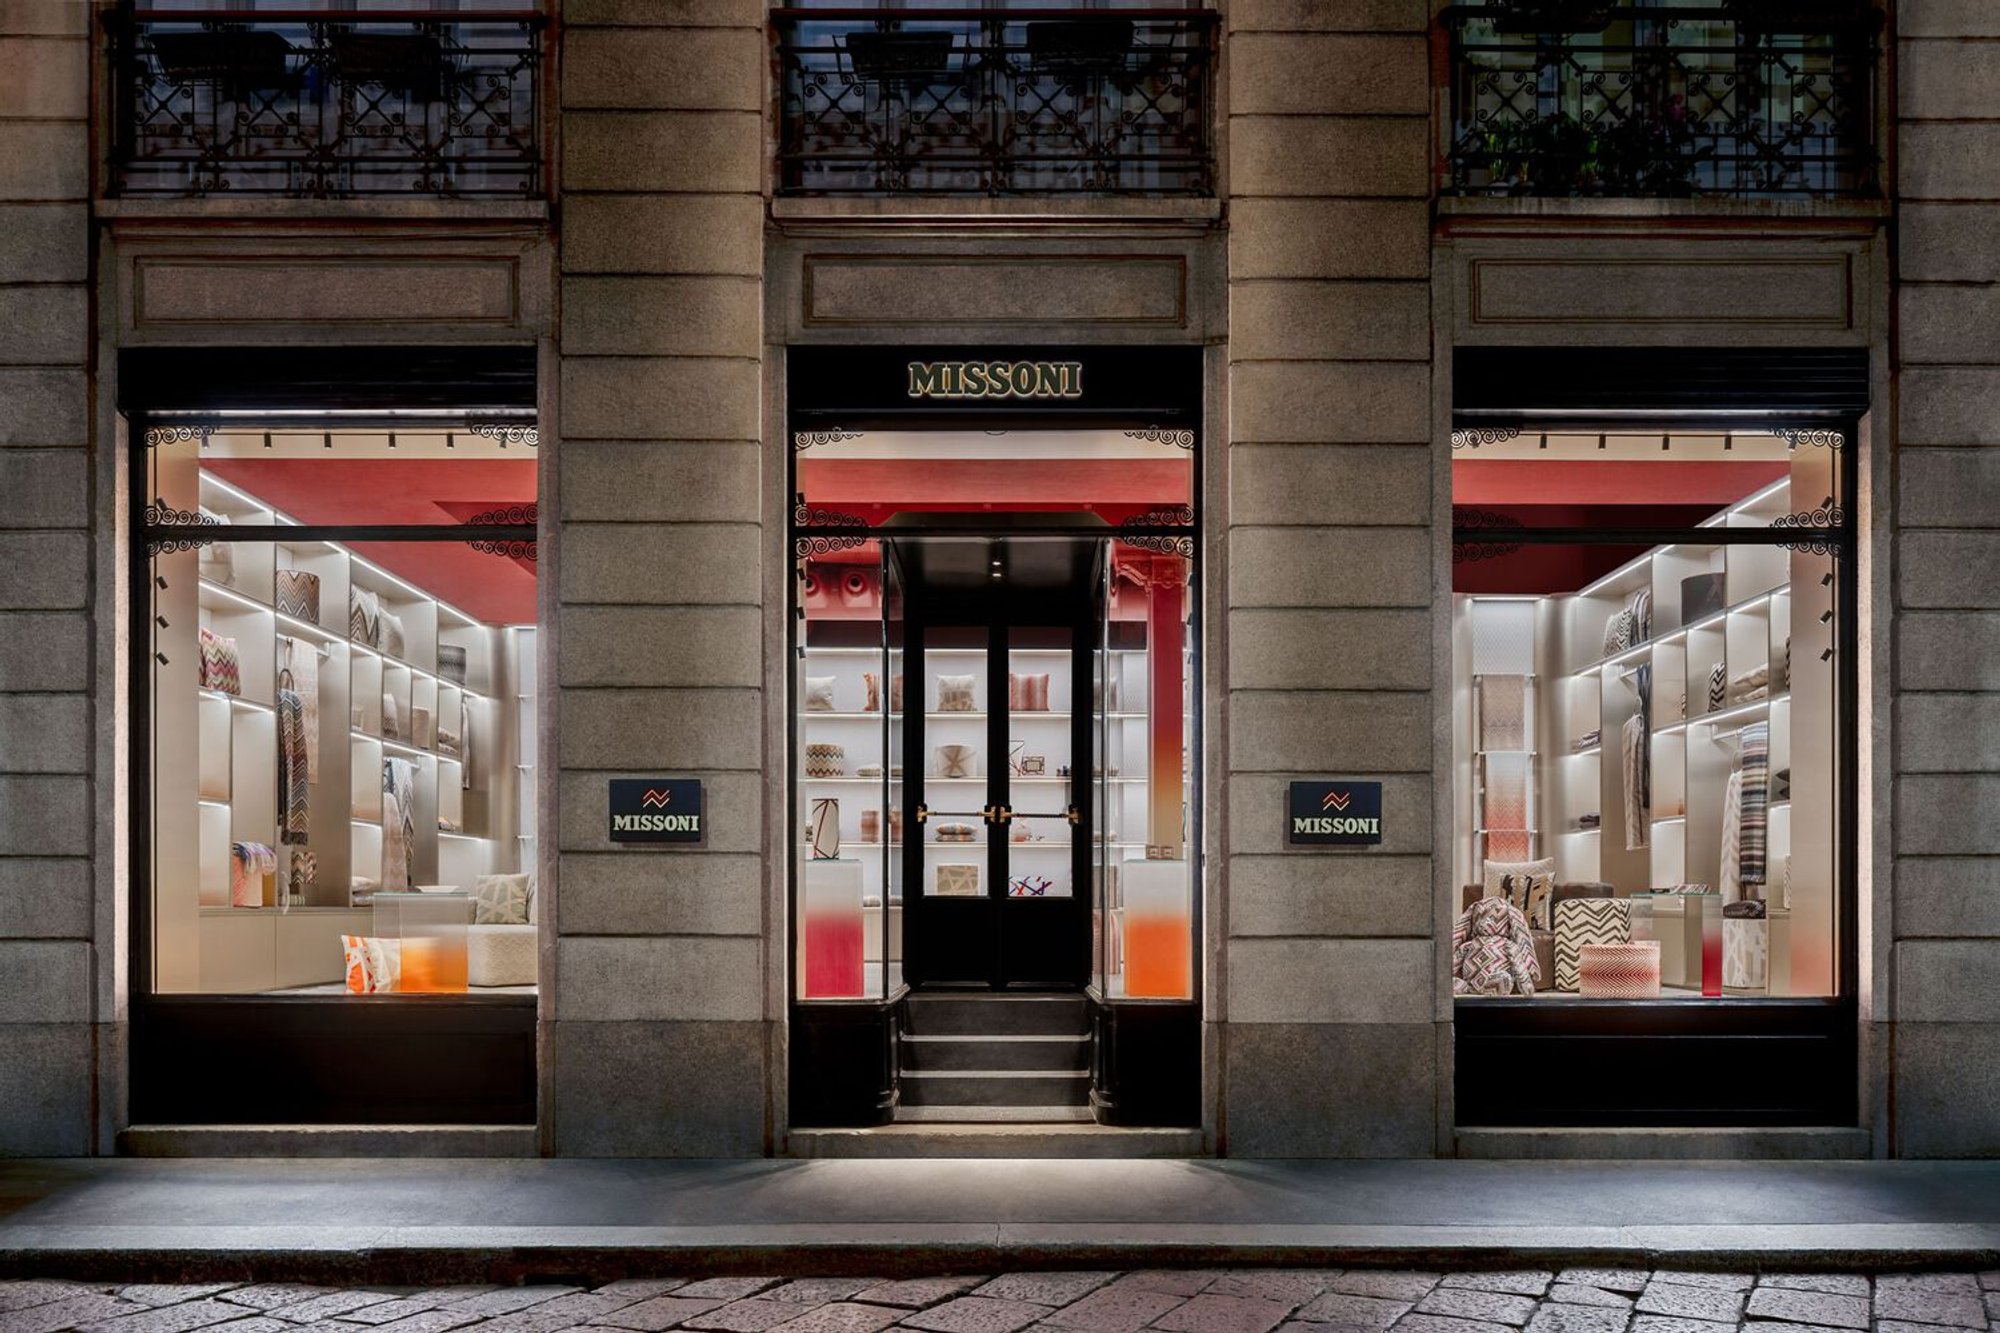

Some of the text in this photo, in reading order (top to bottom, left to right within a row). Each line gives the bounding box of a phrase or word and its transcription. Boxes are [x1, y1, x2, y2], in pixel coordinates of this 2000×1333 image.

[908, 361, 1083, 398] MISSONI
[613, 815, 699, 831] MISSONI
[1294, 817, 1379, 834] MISSONI
